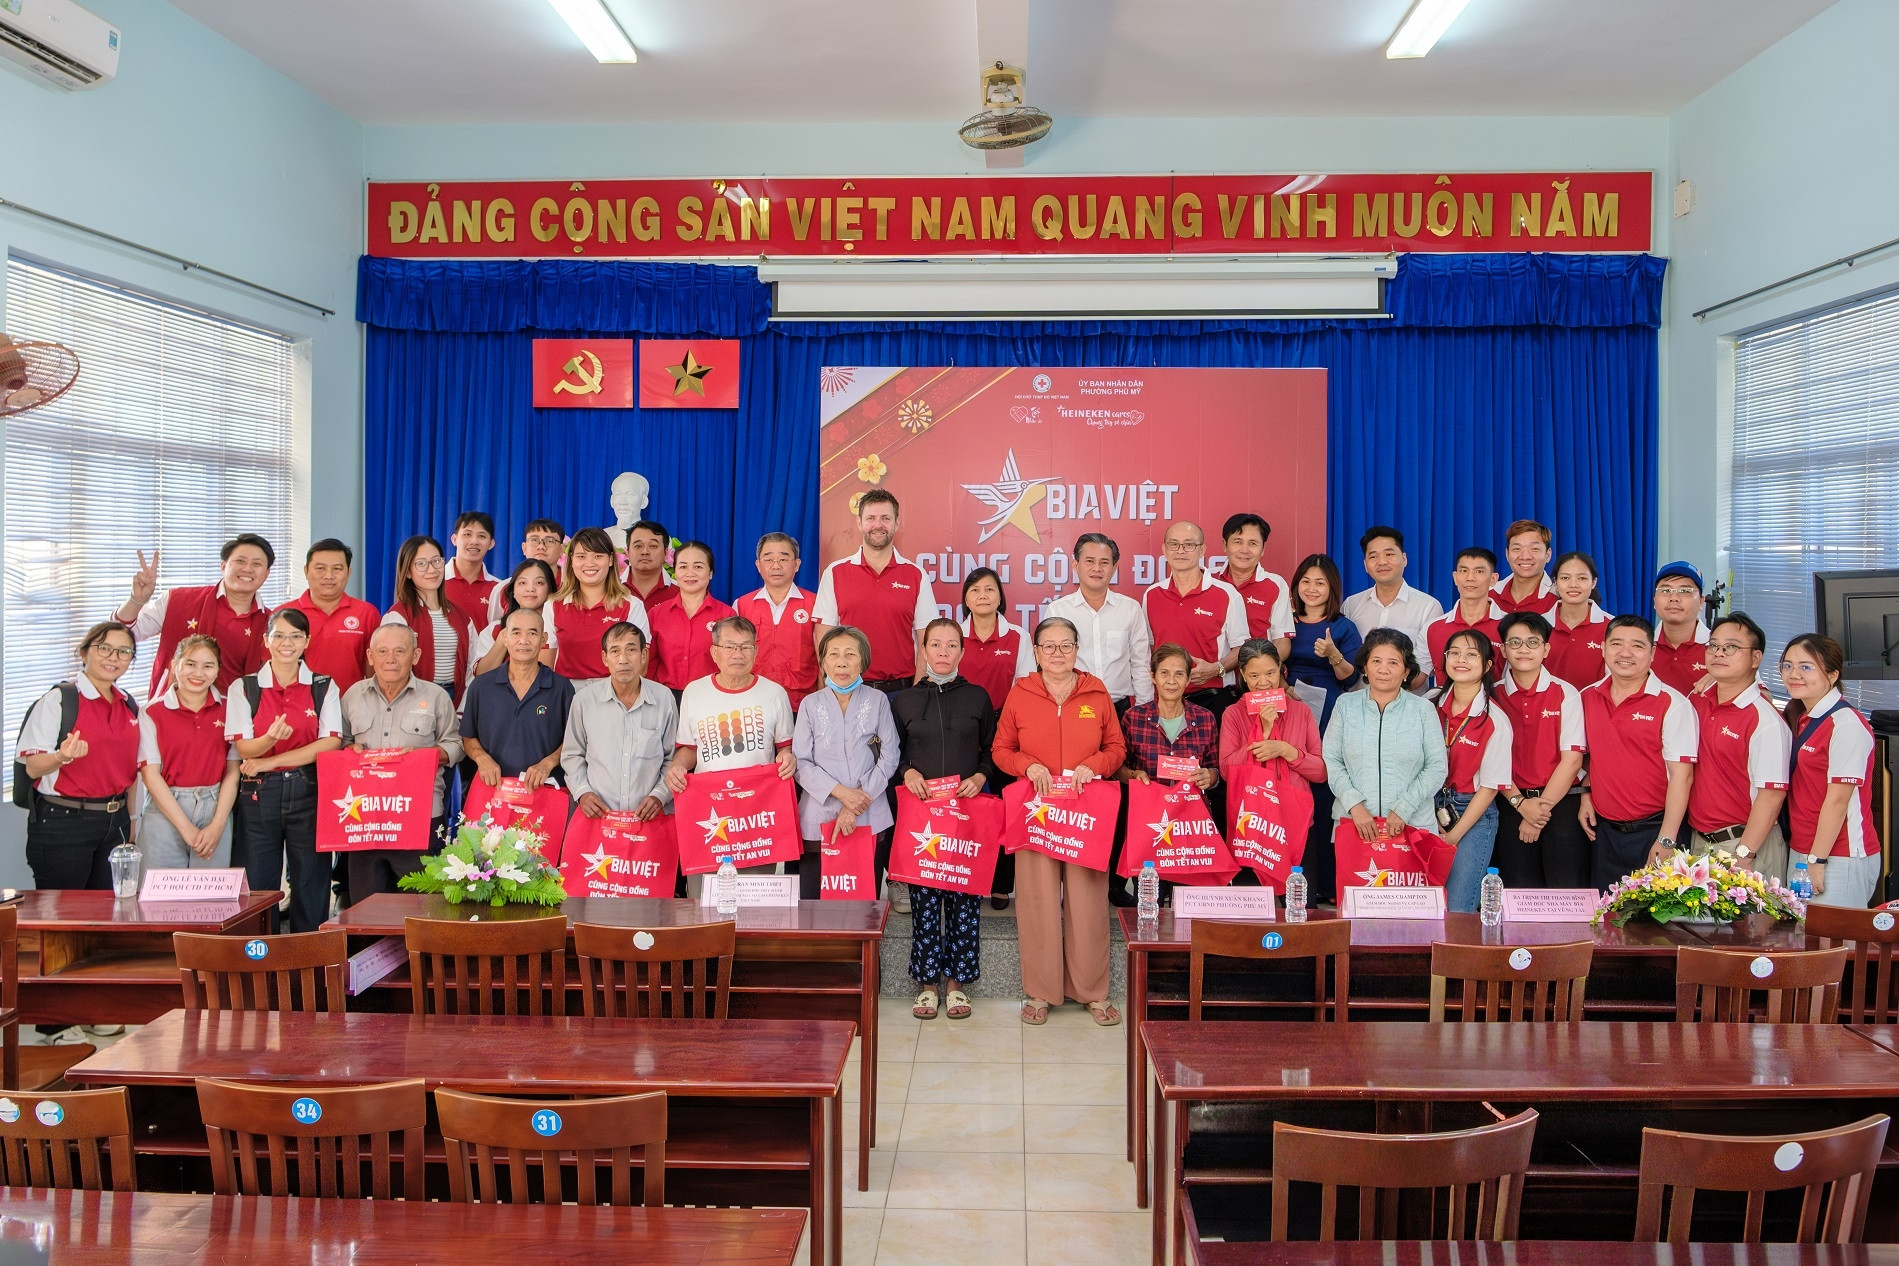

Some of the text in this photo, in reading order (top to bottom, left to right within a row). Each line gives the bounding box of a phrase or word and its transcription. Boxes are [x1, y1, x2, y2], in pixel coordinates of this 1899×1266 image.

[387, 174, 1620, 253] ĐẢNG CỘNG SẢN VIỆT NAM QUANG VINH MUÔN NĂM
[1107, 379, 1127, 387] NHÂN
[1128, 379, 1144, 387] DÂN
[1062, 410, 1111, 418] HEINEKEN
[1104, 479, 1179, 526] VIỆT
[361, 794, 412, 814] BIA VIỆT
[727, 811, 776, 833] BIA VIỆT
[1048, 806, 1096, 831] BIA VIỆT
[344, 822, 363, 833] CÙNG
[364, 822, 380, 834] CỘNG
[1028, 824, 1046, 838] CÙNG
[1046, 831, 1062, 844] CỘNG
[1172, 821, 1191, 836] BIA
[1248, 814, 1287, 845] BIA VIỆ
[374, 834, 382, 842] AN
[385, 834, 397, 842] VUI
[711, 844, 730, 854] CÙNG
[732, 842, 751, 855] CỘNG
[746, 852, 756, 860] AN
[758, 849, 770, 858] VUI
[939, 837, 982, 858] BIA VIỆT
[1054, 846, 1065, 854] AN
[1066, 848, 1078, 858] VUI
[1156, 846, 1174, 856] CÙNG
[1176, 846, 1194, 857] CỘNG
[611, 859, 660, 878] BIA VIỆT
[918, 858, 936, 870] CÙNG
[938, 861, 954, 872] CỘNG
[1190, 858, 1200, 866] AN
[1200, 858, 1212, 866] VUI
[1254, 854, 1264, 864] AN
[1264, 860, 1274, 870] VUI
[831, 874, 857, 892] VIỆT
[948, 875, 957, 884] AN
[958, 876, 968, 886] VUI
[1387, 871, 1406, 886] BIA
[588, 880, 608, 891] CÙNG
[609, 882, 628, 896] CỘNG
[247, 942, 265, 956] 30
[1266, 936, 1279, 948] 01
[296, 1102, 318, 1119] 34
[537, 1114, 557, 1132] 31
